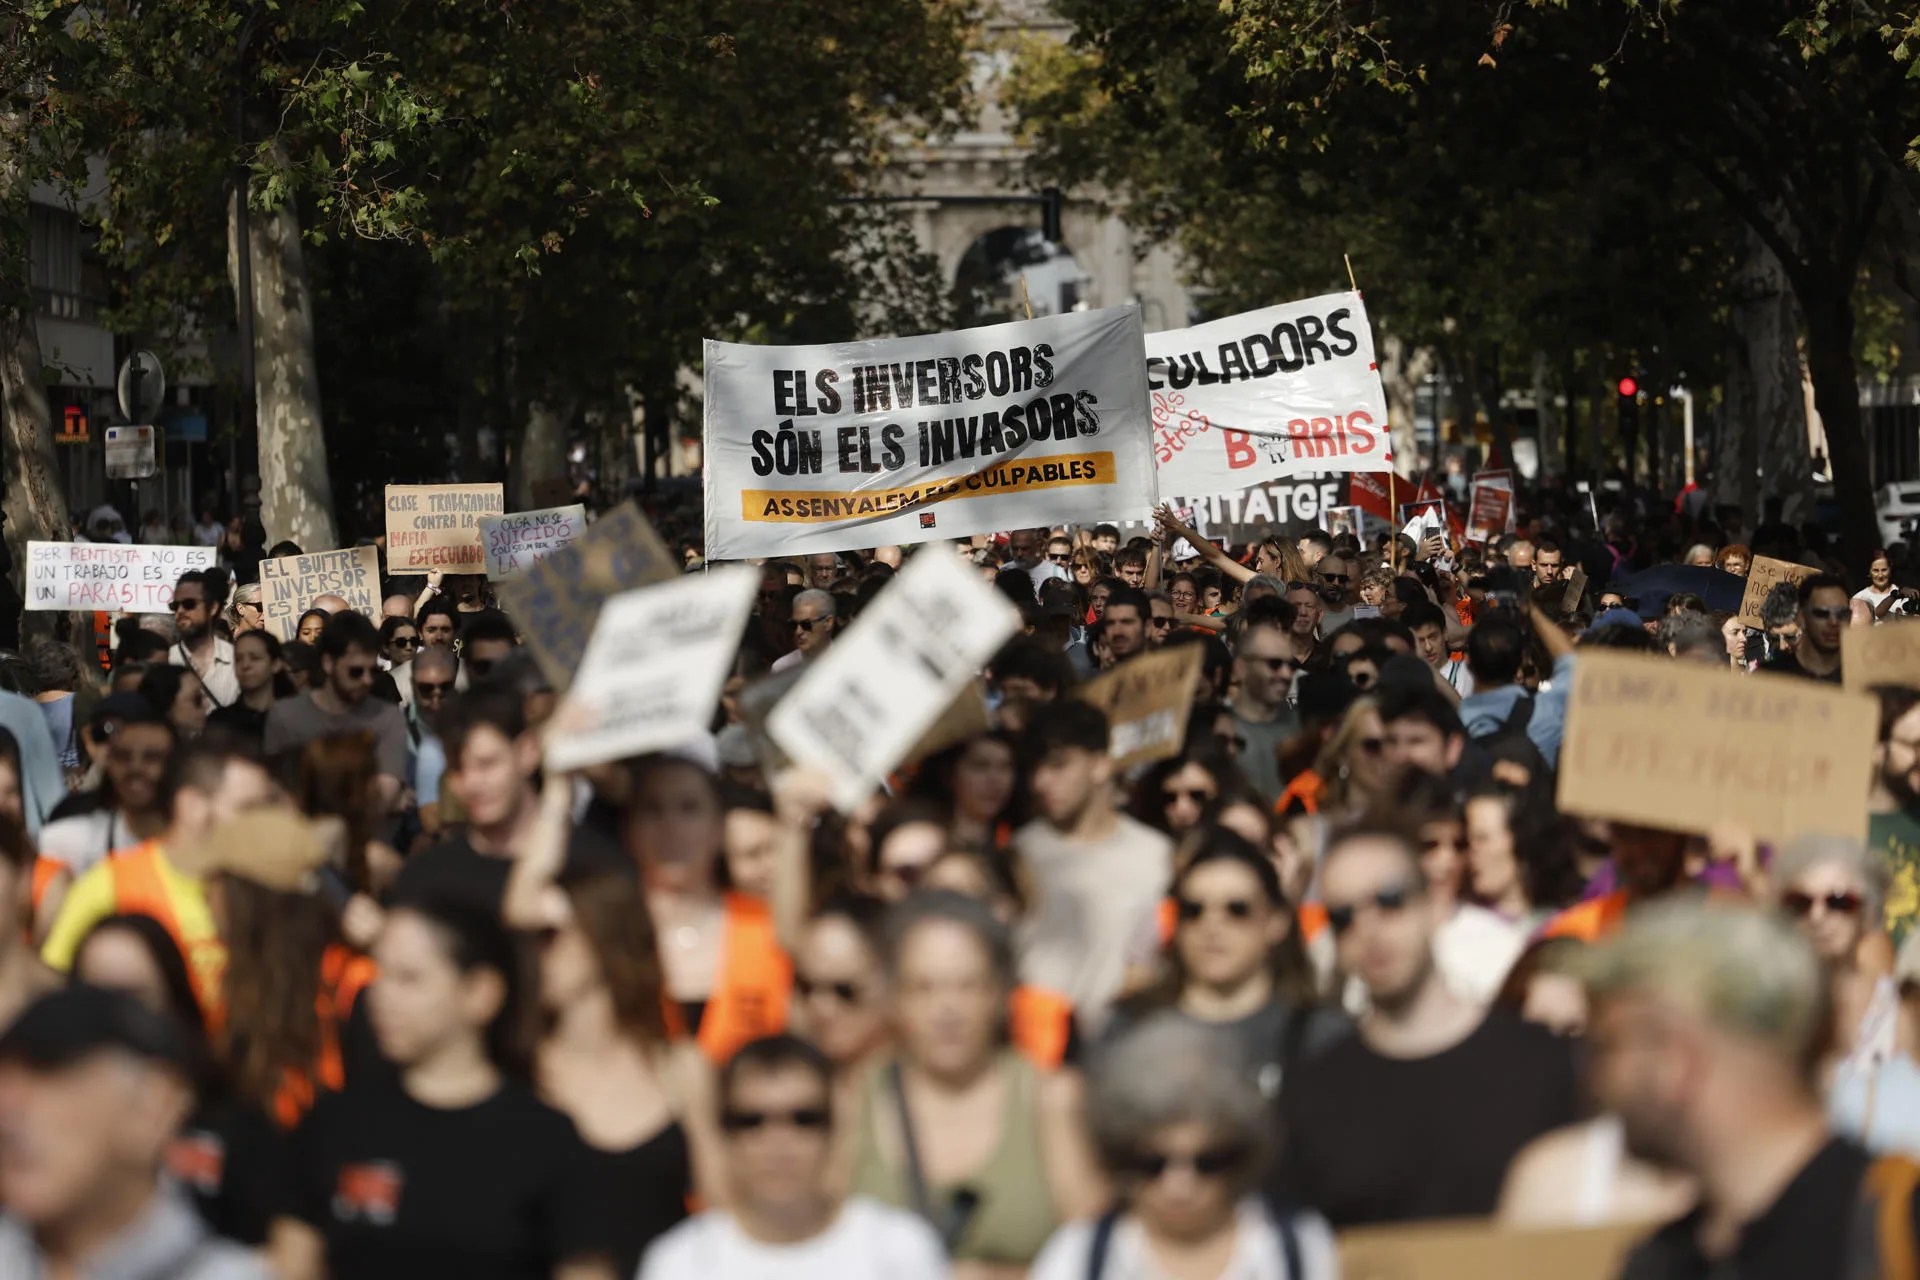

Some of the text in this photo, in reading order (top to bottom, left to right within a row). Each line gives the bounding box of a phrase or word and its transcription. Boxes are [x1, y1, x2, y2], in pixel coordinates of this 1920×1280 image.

[1147, 308, 1358, 390] CULADORS
[773, 343, 1055, 416] ELS INVERSORS
[751, 389, 1101, 477] SÓN ELS INVASORS
[1155, 409, 1209, 471] stres
[1223, 410, 1376, 470] BRRIS
[763, 490, 921, 518] ASSENYALEM
[965, 460, 1096, 491] CULPABLES
[387, 493, 503, 512] CLASE TRABAJADORA
[413, 514, 474, 529] CONTRA LA
[490, 517, 573, 548] SUICIDÓ
[501, 517, 531, 532] OLGA
[535, 514, 550, 526] NO
[33, 546, 206, 565] SER RENTISTA NO ES
[263, 549, 363, 578] EL BUITRE
[498, 554, 521, 576] LA
[34, 566, 56, 580] UN
[64, 565, 129, 580] TRABAJO
[143, 566, 163, 580] ES
[1756, 564, 1777, 577] se
[36, 582, 175, 605] UN PARASITO
[272, 568, 367, 601] INVERSOR
[1751, 580, 1769, 597] no
[267, 600, 292, 618] ES
